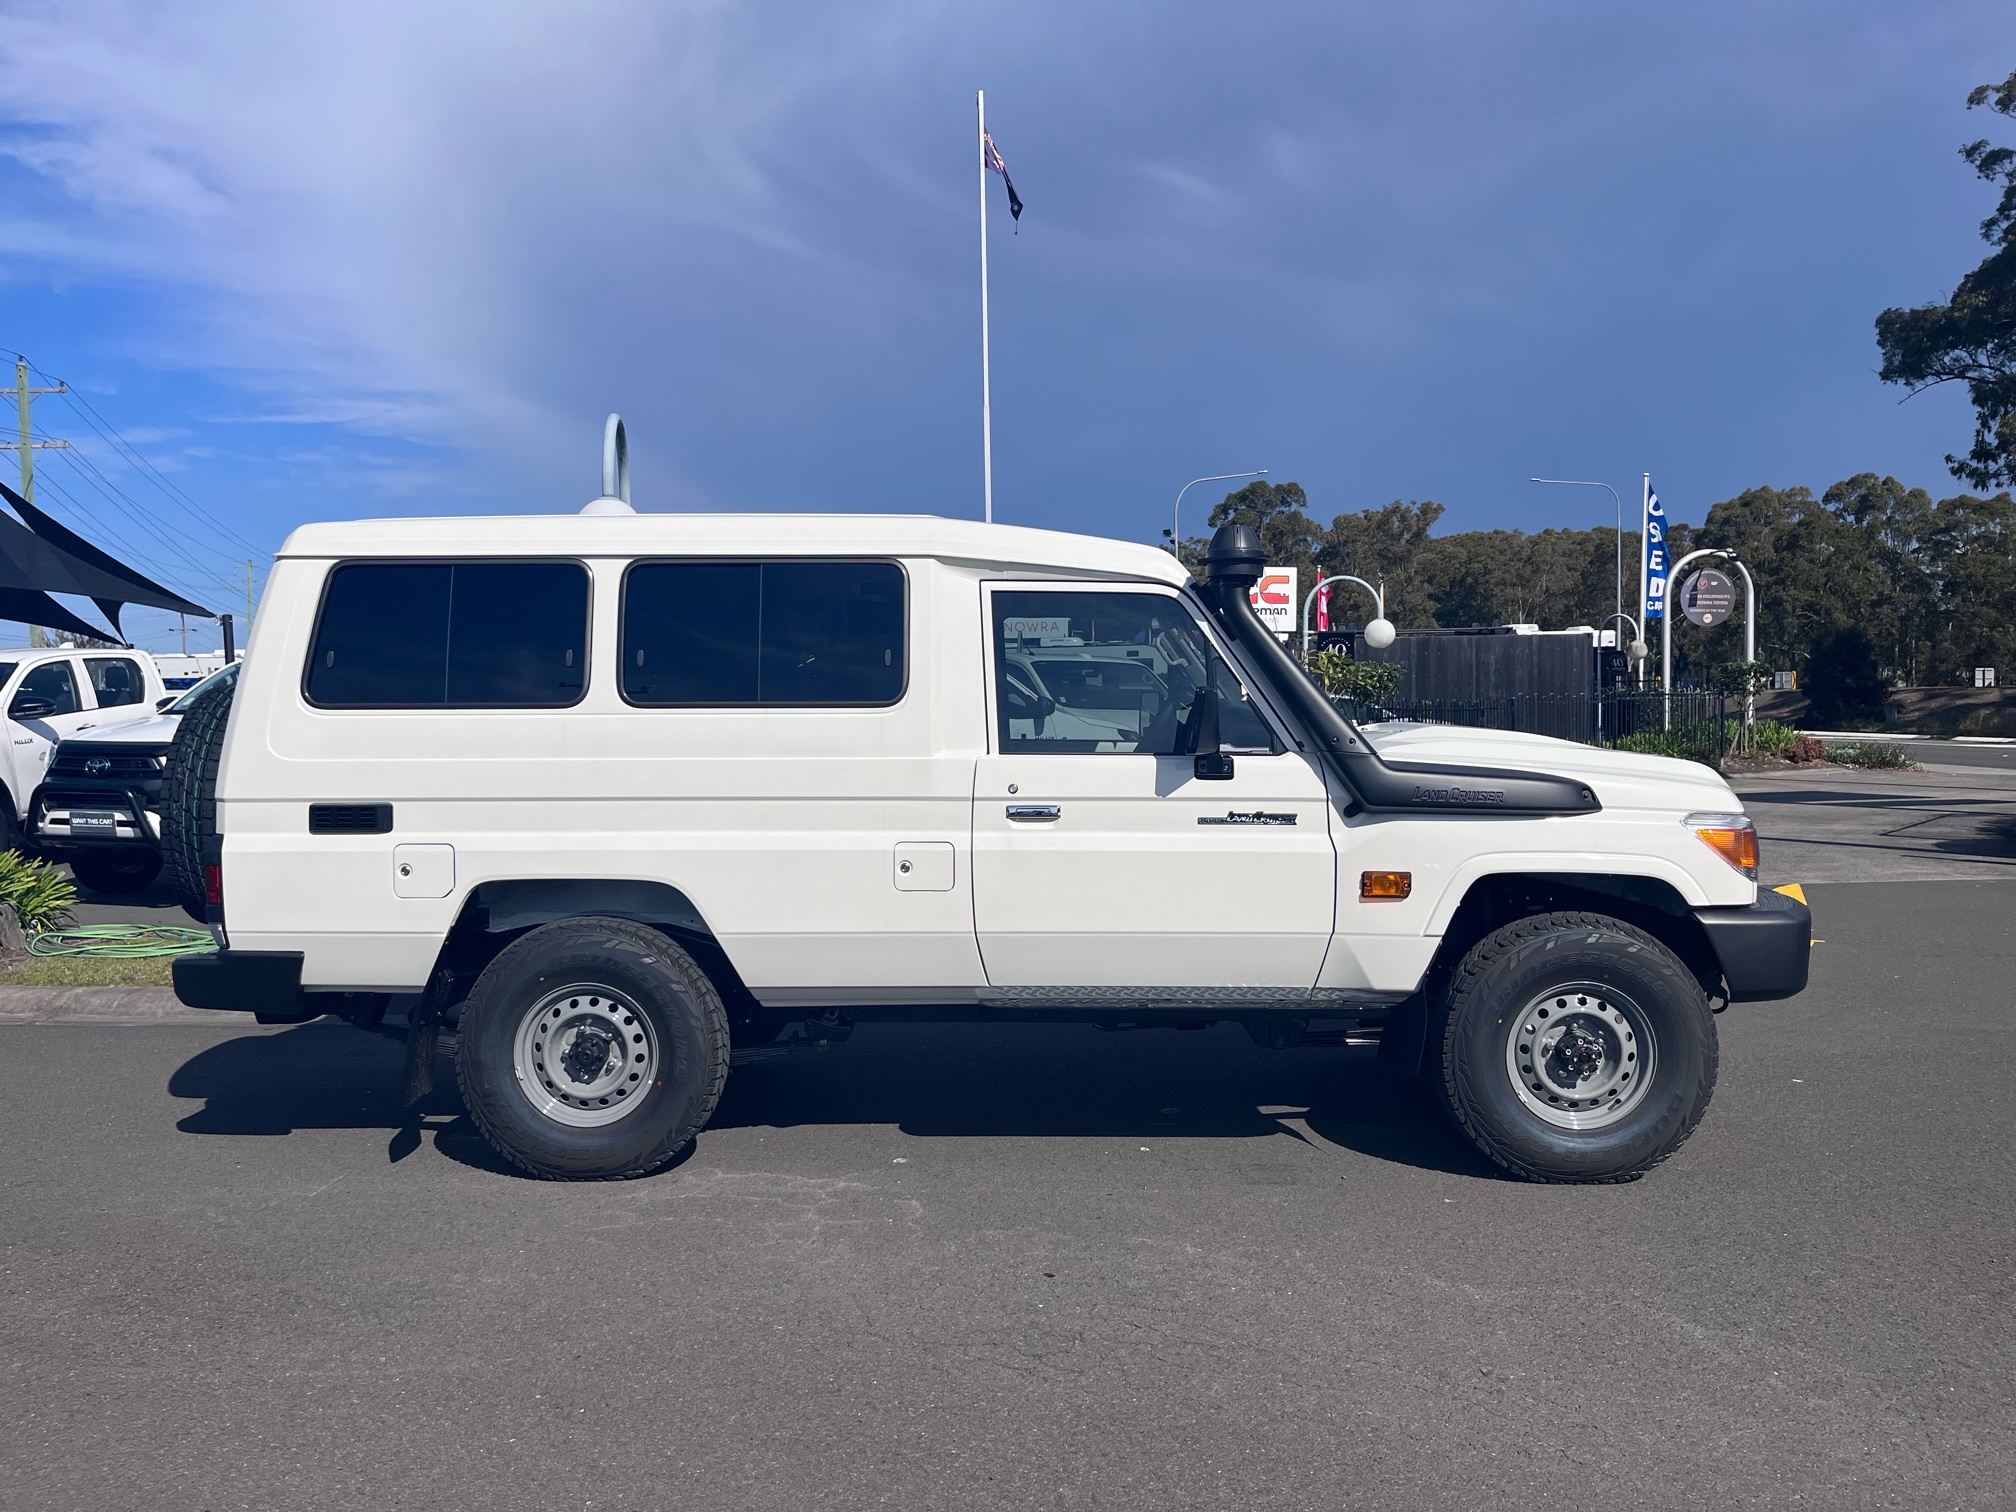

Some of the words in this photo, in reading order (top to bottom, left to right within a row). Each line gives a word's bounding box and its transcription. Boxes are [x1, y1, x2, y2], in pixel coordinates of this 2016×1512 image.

[1647, 601, 1663, 611] CAR
[1004, 621, 1060, 633] NOWRA
[1411, 786, 1449, 802] LAND
[1449, 787, 1504, 805] CRUISER
